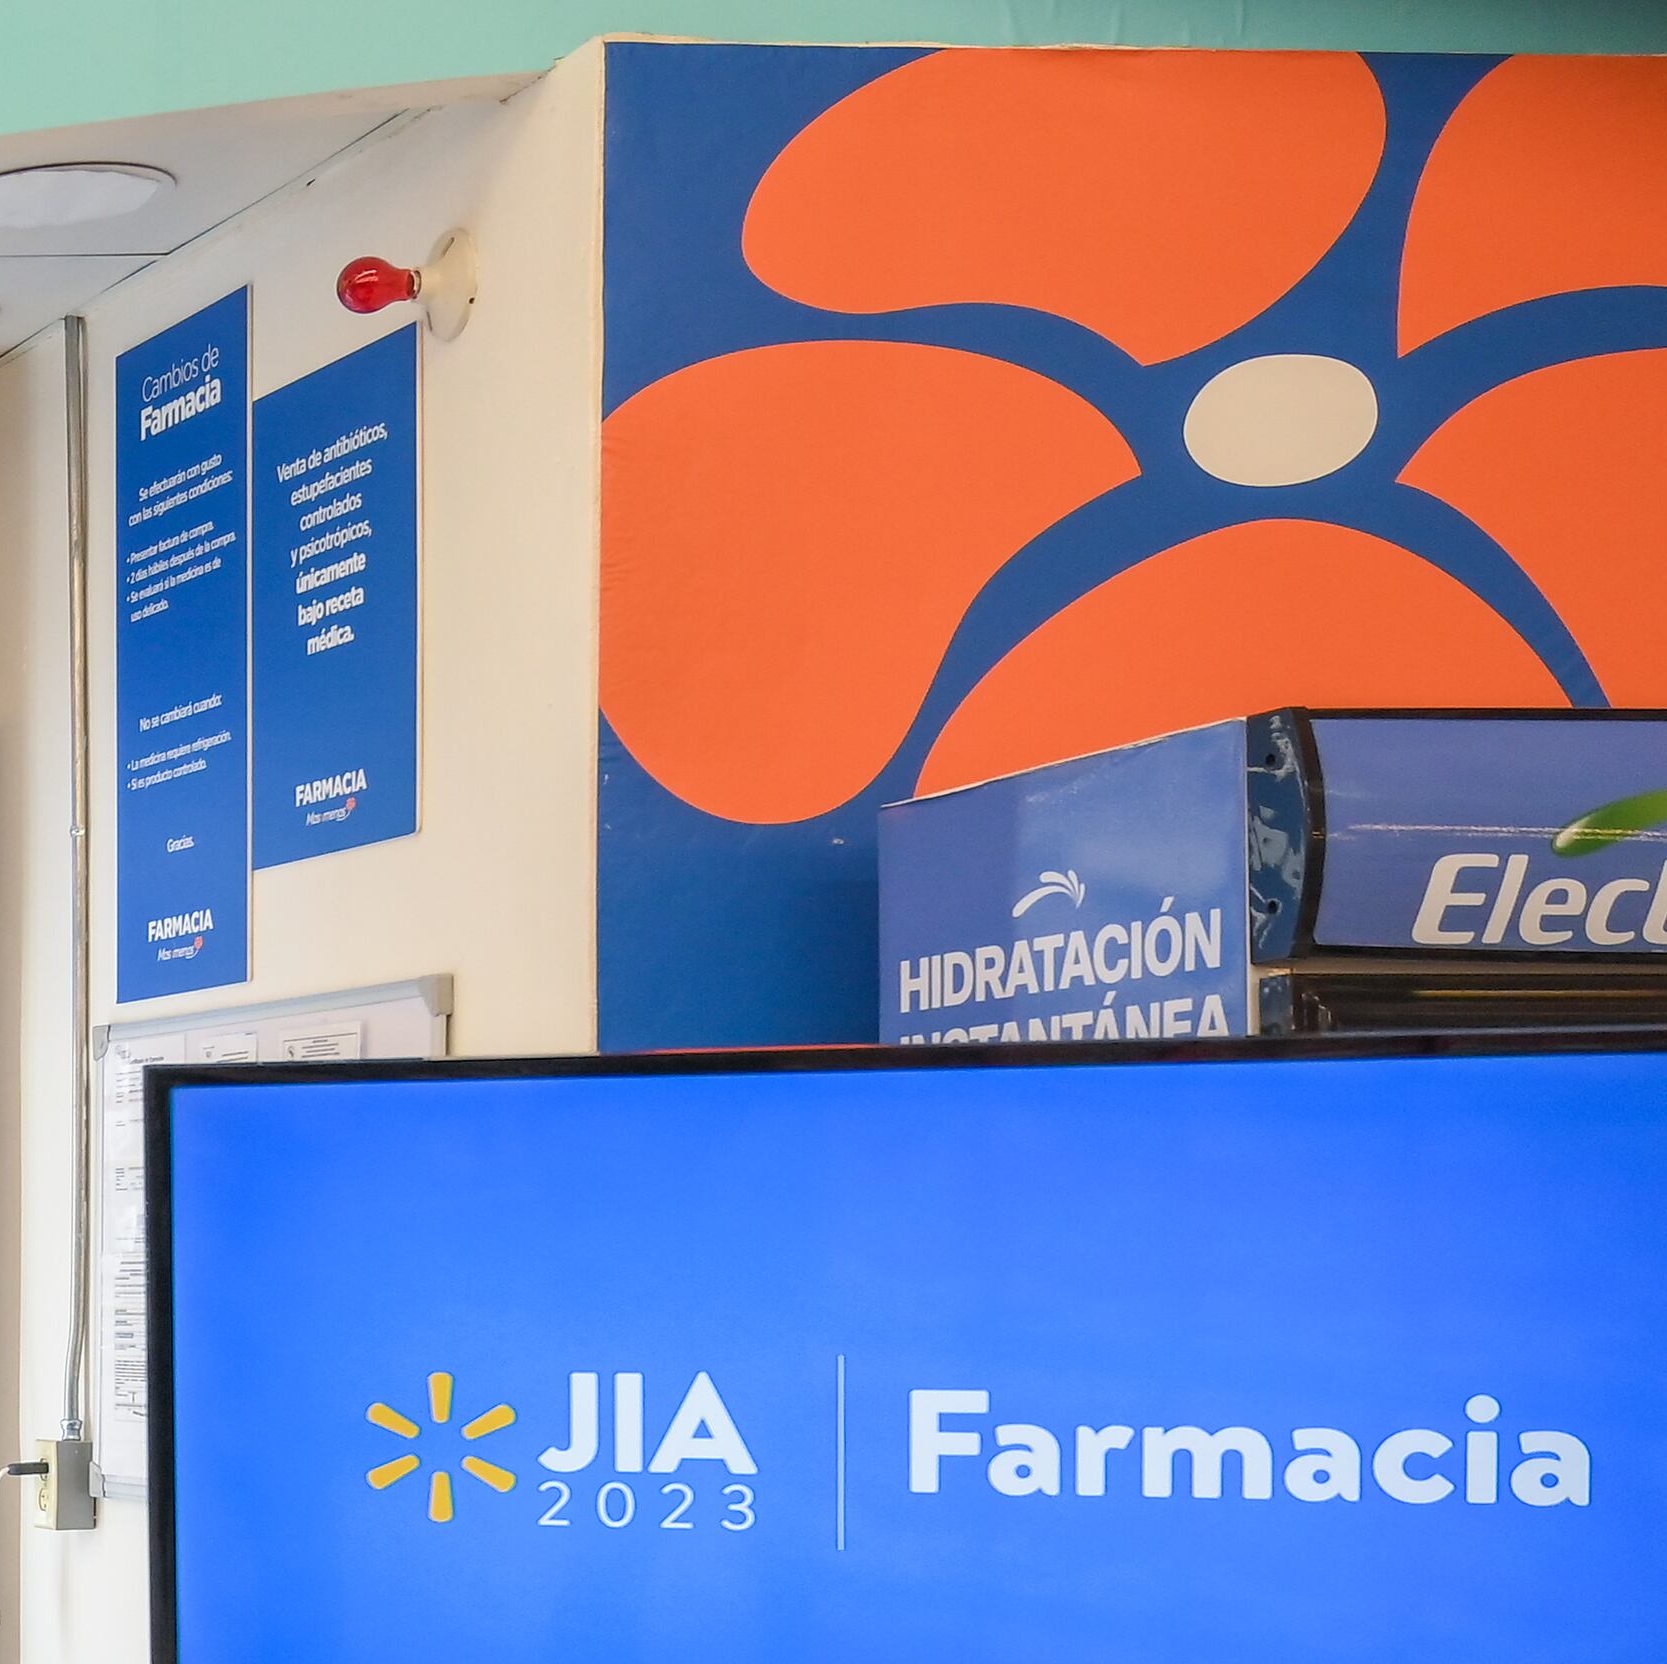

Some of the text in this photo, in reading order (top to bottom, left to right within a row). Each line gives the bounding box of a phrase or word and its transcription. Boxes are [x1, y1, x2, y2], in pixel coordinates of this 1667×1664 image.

[142, 344, 219, 403] Cambios de
[139, 375, 221, 441] Farmacia
[277, 421, 387, 483] Venta de antibióticos,
[139, 488, 148, 502] Se
[187, 464, 200, 479] con
[201, 454, 222, 475] gusto
[290, 457, 373, 506] estupefacientes
[299, 492, 363, 532] controlados
[290, 519, 372, 568] y psicotrópicos,
[296, 551, 366, 594] únicamente
[298, 585, 364, 627] bajo receta
[307, 624, 354, 656] médica.
[139, 717, 151, 732] No
[295, 768, 367, 808] FARMACIA
[306, 803, 347, 827] Masmenos
[147, 909, 214, 943] FARMACIA
[157, 944, 195, 962] Masmenos
[900, 896, 1221, 1013] HIDRATACIÓN
[537, 1371, 759, 1477] JIA
[909, 1389, 1592, 1510] Farmacia
[538, 1479, 757, 1533] 2023
